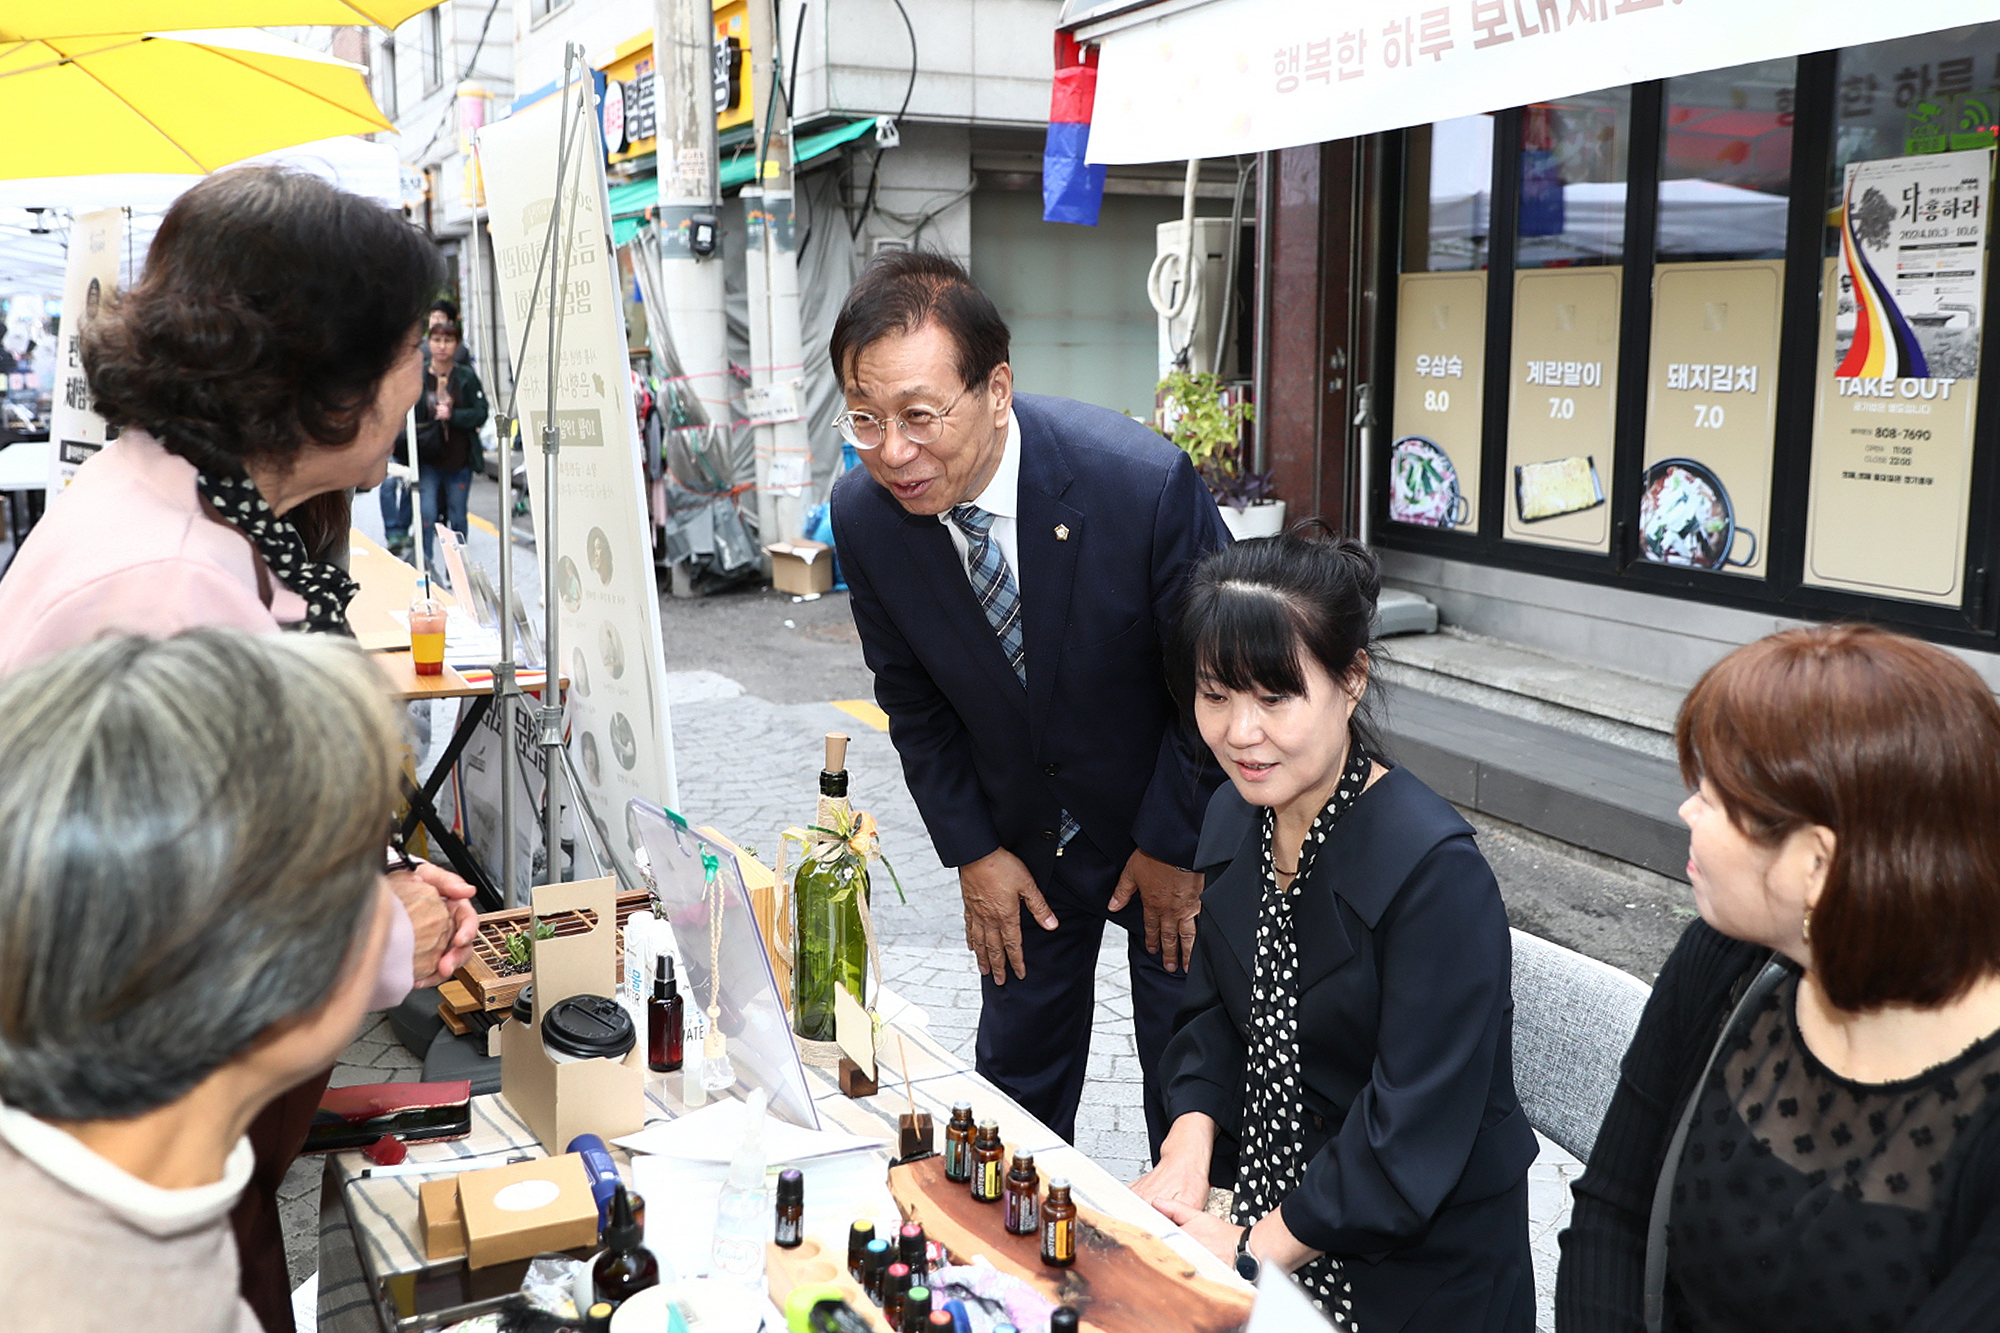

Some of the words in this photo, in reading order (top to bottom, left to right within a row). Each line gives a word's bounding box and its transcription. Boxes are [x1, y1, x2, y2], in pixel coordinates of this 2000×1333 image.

[1274, 28, 1368, 94] 행복한
[1382, 5, 1454, 68] 하루
[1415, 354, 1464, 380] 우삼숙
[1526, 360, 1603, 388] 계란말이
[1666, 363, 1759, 393] 돼지김치
[1836, 377, 1895, 398] TAKE
[1900, 378, 1957, 400] OUT
[1424, 390, 1450, 412] 8.0
[1549, 398, 1575, 419] 7.0
[1693, 405, 1724, 429] 7.0
[1875, 427, 1931, 441] 808-7690
